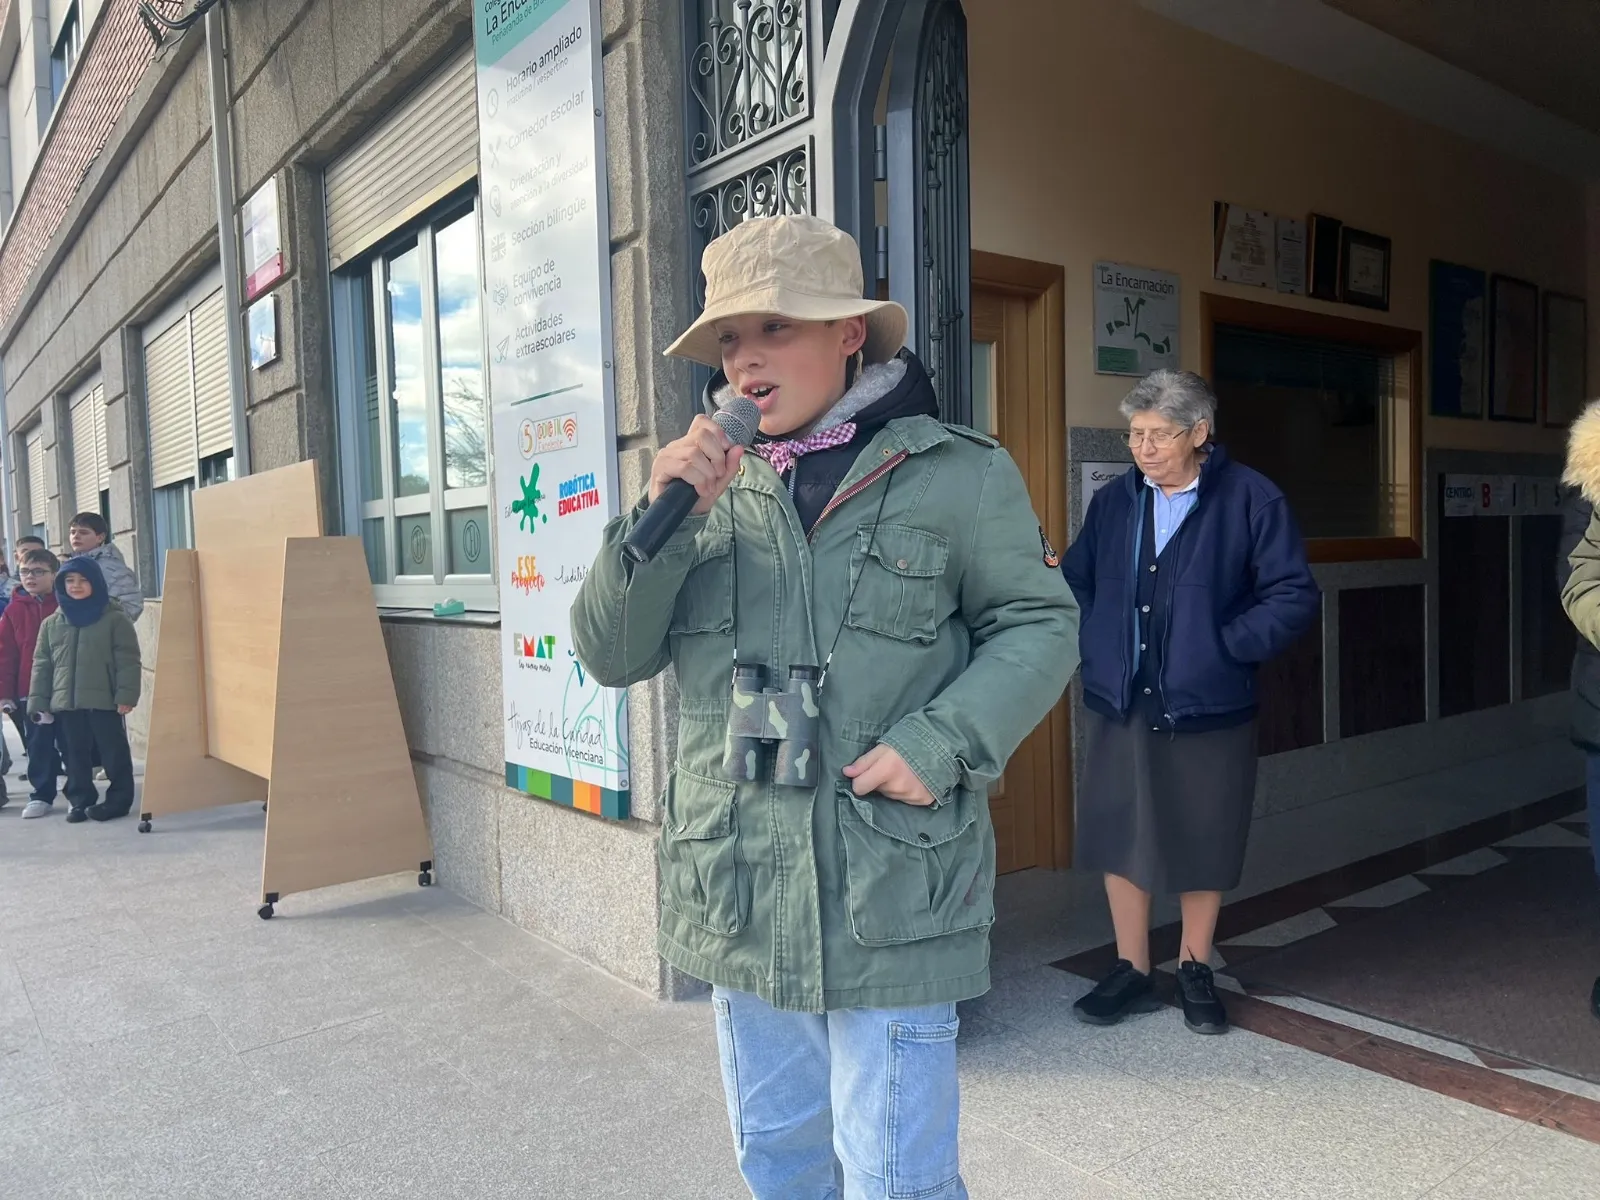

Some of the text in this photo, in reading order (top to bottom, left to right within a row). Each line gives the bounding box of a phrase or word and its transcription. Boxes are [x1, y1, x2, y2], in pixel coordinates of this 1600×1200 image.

[486, 15, 498, 36] La
[506, 26, 582, 93] Horario ampliado
[537, 57, 569, 86] vespertino
[507, 90, 585, 150] Comedor escolar
[509, 151, 562, 191] Orientación y
[551, 156, 589, 186] diversidad
[511, 197, 587, 247] Sección bilingüe
[513, 258, 555, 288] Equipo de
[1101, 269, 1113, 285] La
[1115, 272, 1175, 295] Encarnación
[513, 275, 562, 307] convivencia
[515, 312, 563, 342] Actividades
[515, 328, 576, 359] extraescolares
[523, 424, 533, 453] 5
[558, 471, 596, 499] ROBÓTICA
[1091, 470, 1120, 482] Secret
[558, 488, 600, 517] EDUCATIVA
[513, 632, 556, 660] EMAT
[507, 699, 604, 750] Hijas de la Caridad
[529, 737, 604, 765] Educación Vicenciana
